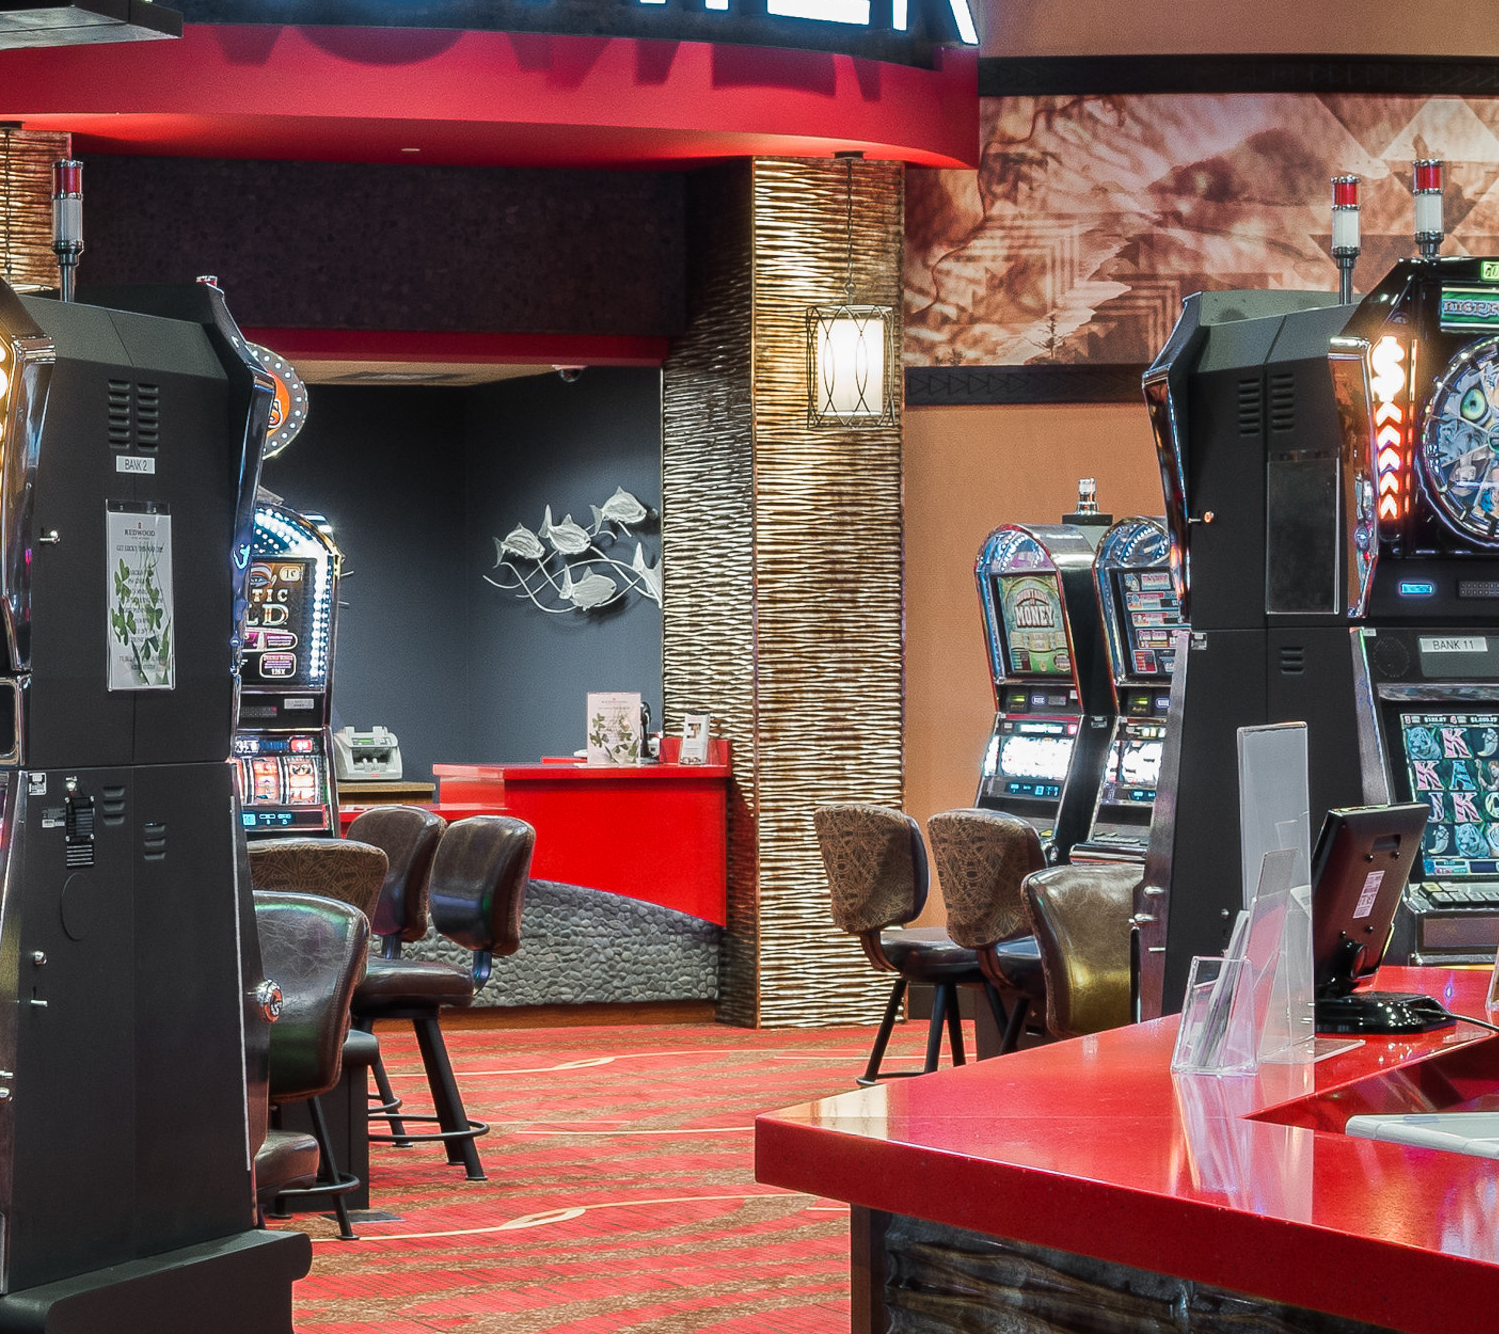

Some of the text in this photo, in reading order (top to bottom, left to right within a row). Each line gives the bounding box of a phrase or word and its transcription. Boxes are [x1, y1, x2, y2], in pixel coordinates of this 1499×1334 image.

[124, 458, 143, 471] BANK
[124, 528, 156, 537] REDWOOD
[1014, 605, 1055, 628] MONEY
[1433, 639, 1475, 650] BANK 11
[1440, 728, 1472, 758] K
[1413, 760, 1445, 791] K
[1449, 760, 1476, 791] A
[1428, 792, 1445, 823] J
[1450, 792, 1483, 823] K
